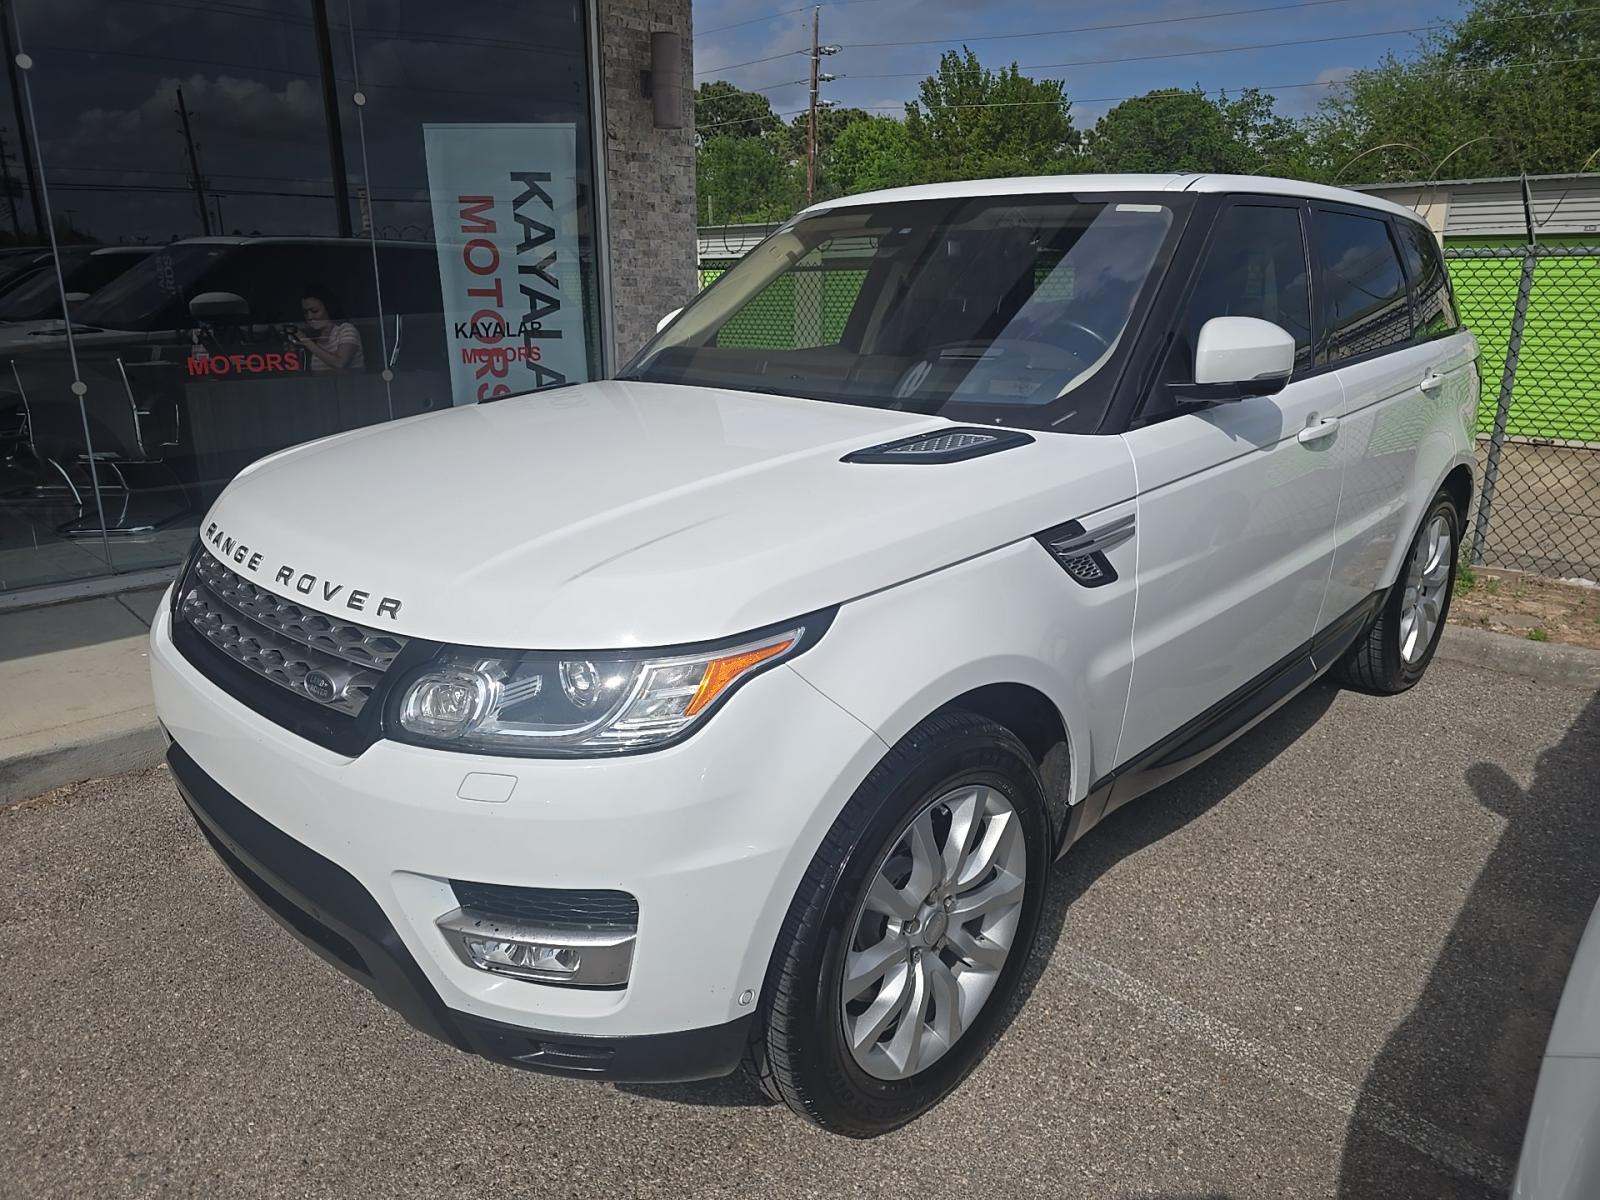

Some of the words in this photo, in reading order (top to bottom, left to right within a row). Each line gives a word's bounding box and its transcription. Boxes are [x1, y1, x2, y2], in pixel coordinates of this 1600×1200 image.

[454, 321, 542, 339] KAYALAR
[186, 351, 300, 376] MOTORS
[461, 346, 541, 364] MOTORS
[205, 522, 264, 571] RANGE
[275, 565, 402, 620] ROVER
